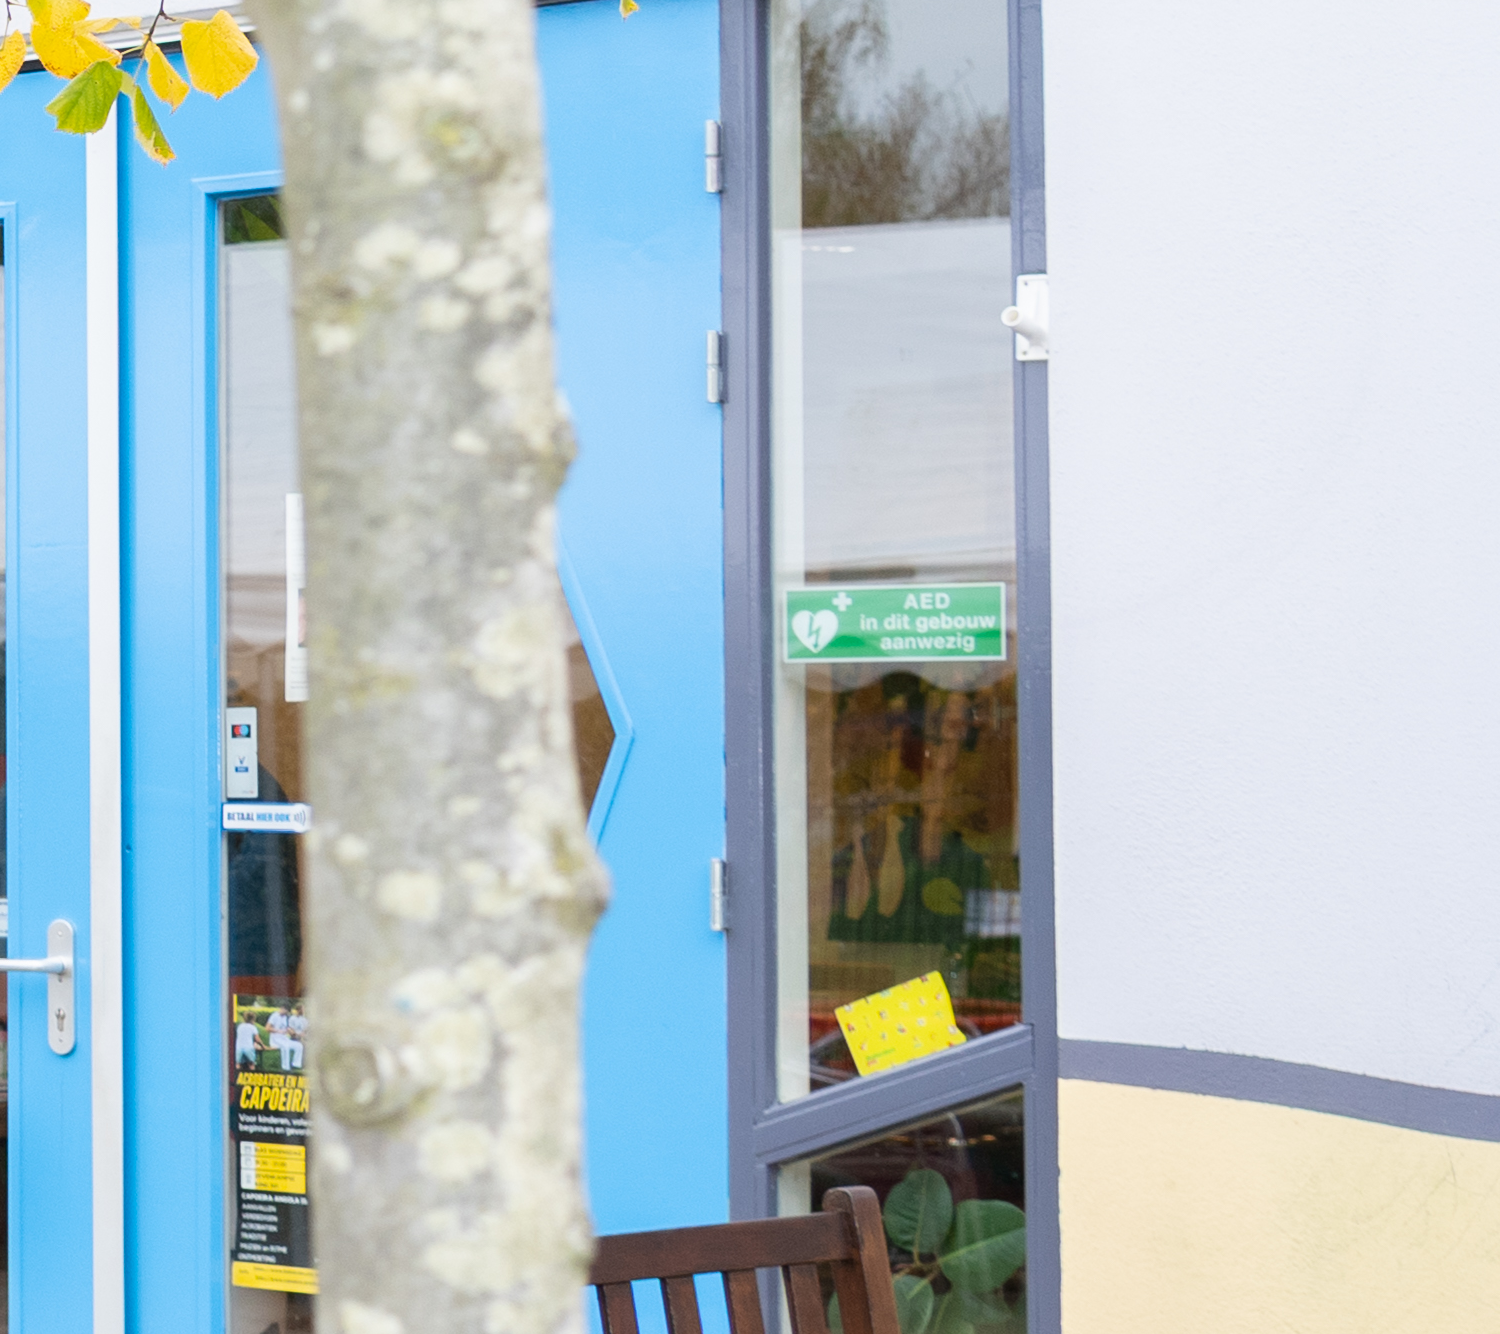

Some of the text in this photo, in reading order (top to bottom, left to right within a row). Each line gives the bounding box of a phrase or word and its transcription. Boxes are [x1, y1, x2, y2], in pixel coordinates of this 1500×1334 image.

[903, 592, 951, 611] AED
[859, 613, 996, 634] in dit gebouw
[880, 633, 976, 653] aanwezig
[227, 812, 292, 822] BETAAL HIER OOK
[236, 1072, 285, 1087] ACROBATIEK
[240, 1086, 310, 1113] CAPOEIRA
[238, 1113, 256, 1123] Voor
